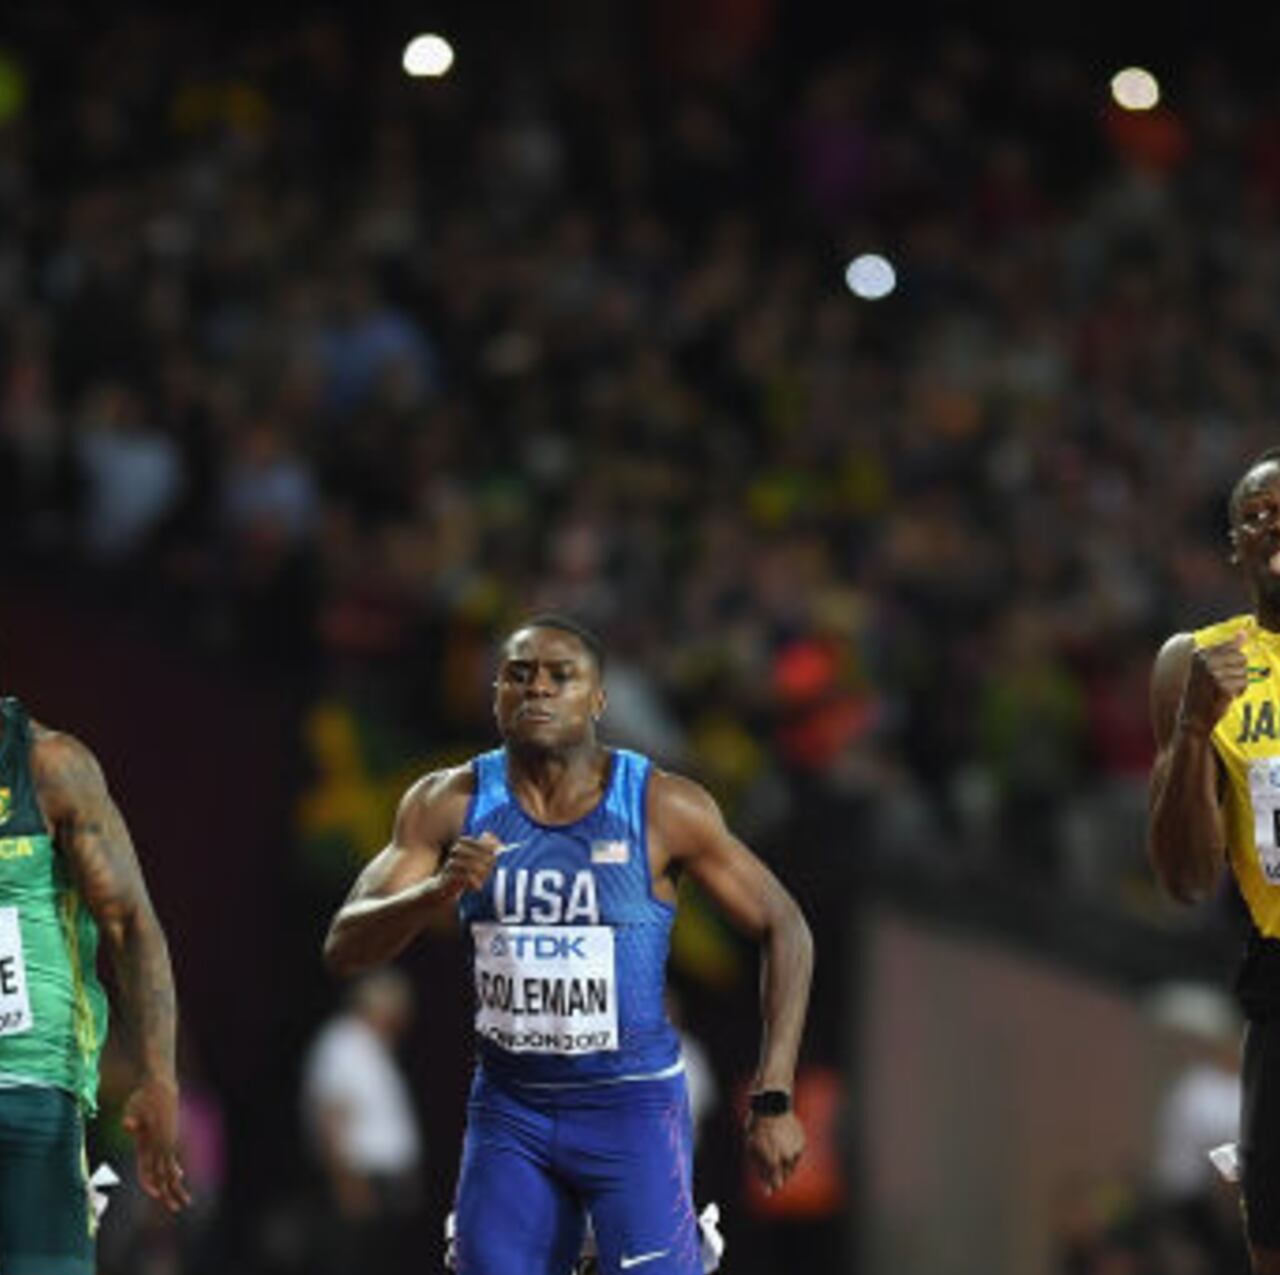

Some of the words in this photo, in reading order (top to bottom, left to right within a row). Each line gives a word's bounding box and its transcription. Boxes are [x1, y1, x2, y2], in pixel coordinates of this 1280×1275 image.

[495, 868, 598, 925] USA
[507, 935, 586, 960] TDK
[481, 971, 607, 1016] COLEMAN
